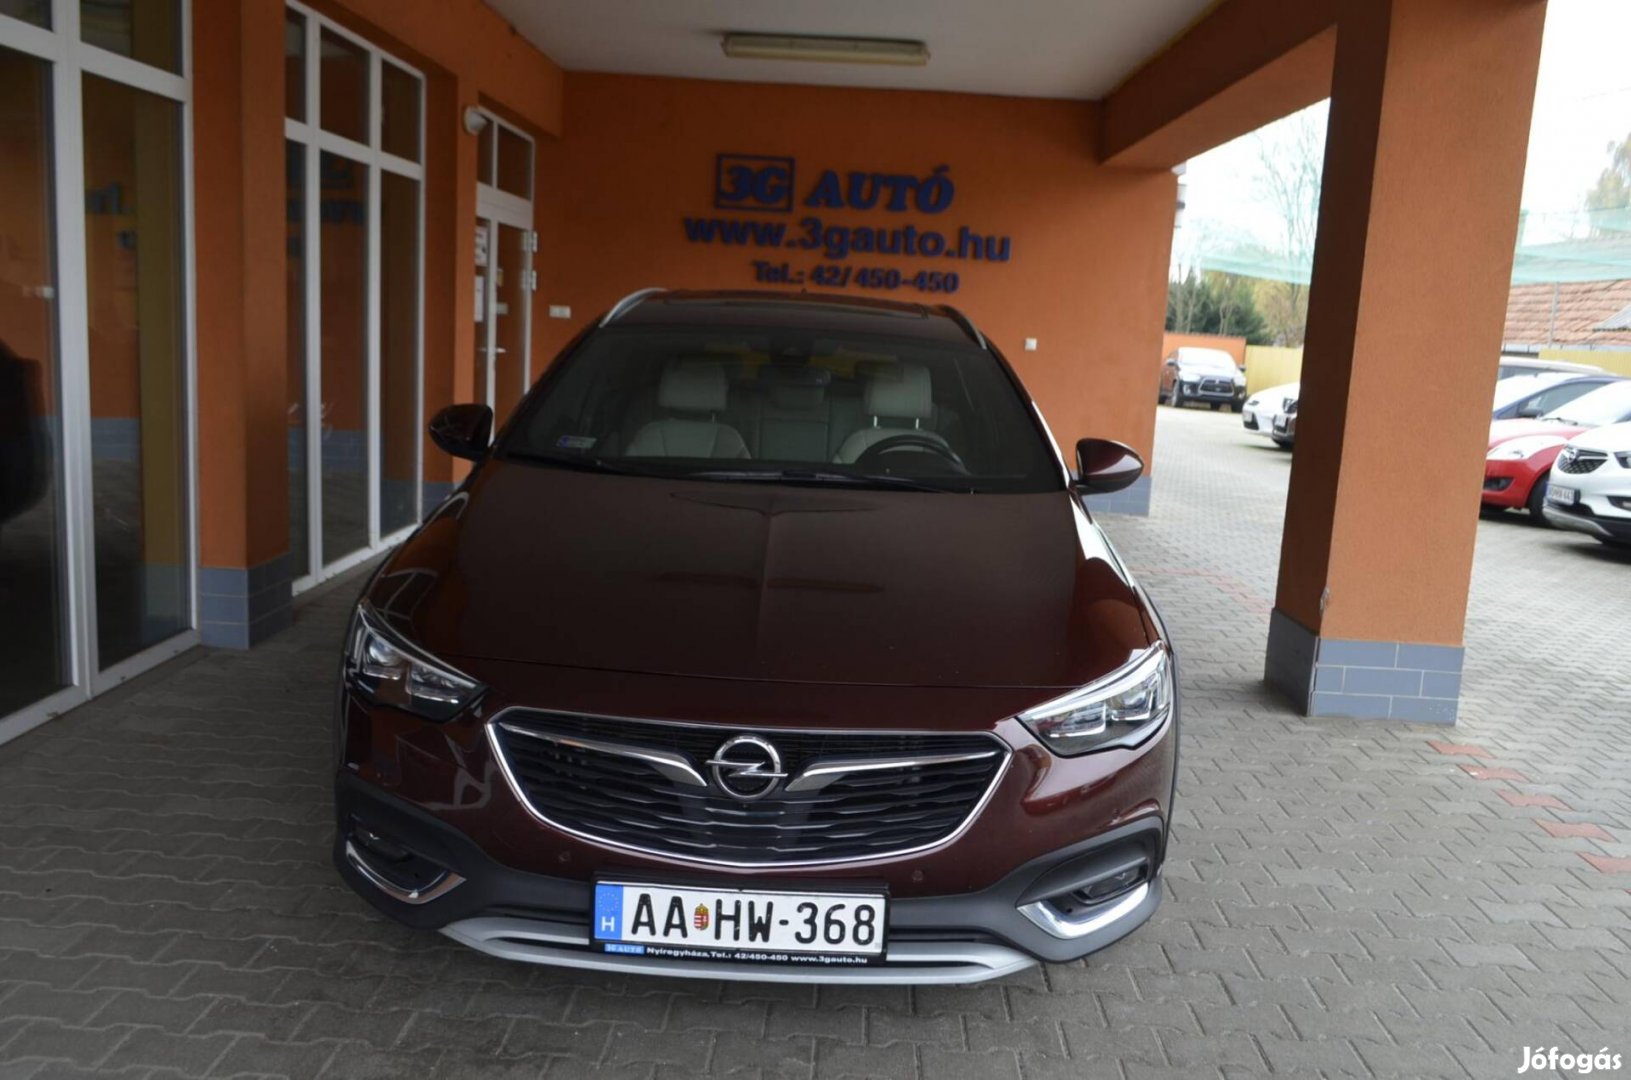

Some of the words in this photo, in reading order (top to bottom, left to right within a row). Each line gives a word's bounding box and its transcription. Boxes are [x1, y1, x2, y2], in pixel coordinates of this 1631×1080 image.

[723, 164, 788, 203] 3G
[804, 165, 955, 214] AUTÓ
[683, 215, 1011, 262] www.3gauto.hu
[753, 260, 805, 284] Tel.:
[601, 916, 615, 932] H
[631, 893, 688, 939] AA
[714, 898, 876, 946] HW-368
[734, 952, 788, 961] 42/450-450
[790, 955, 868, 964] www.3gauto.hu
